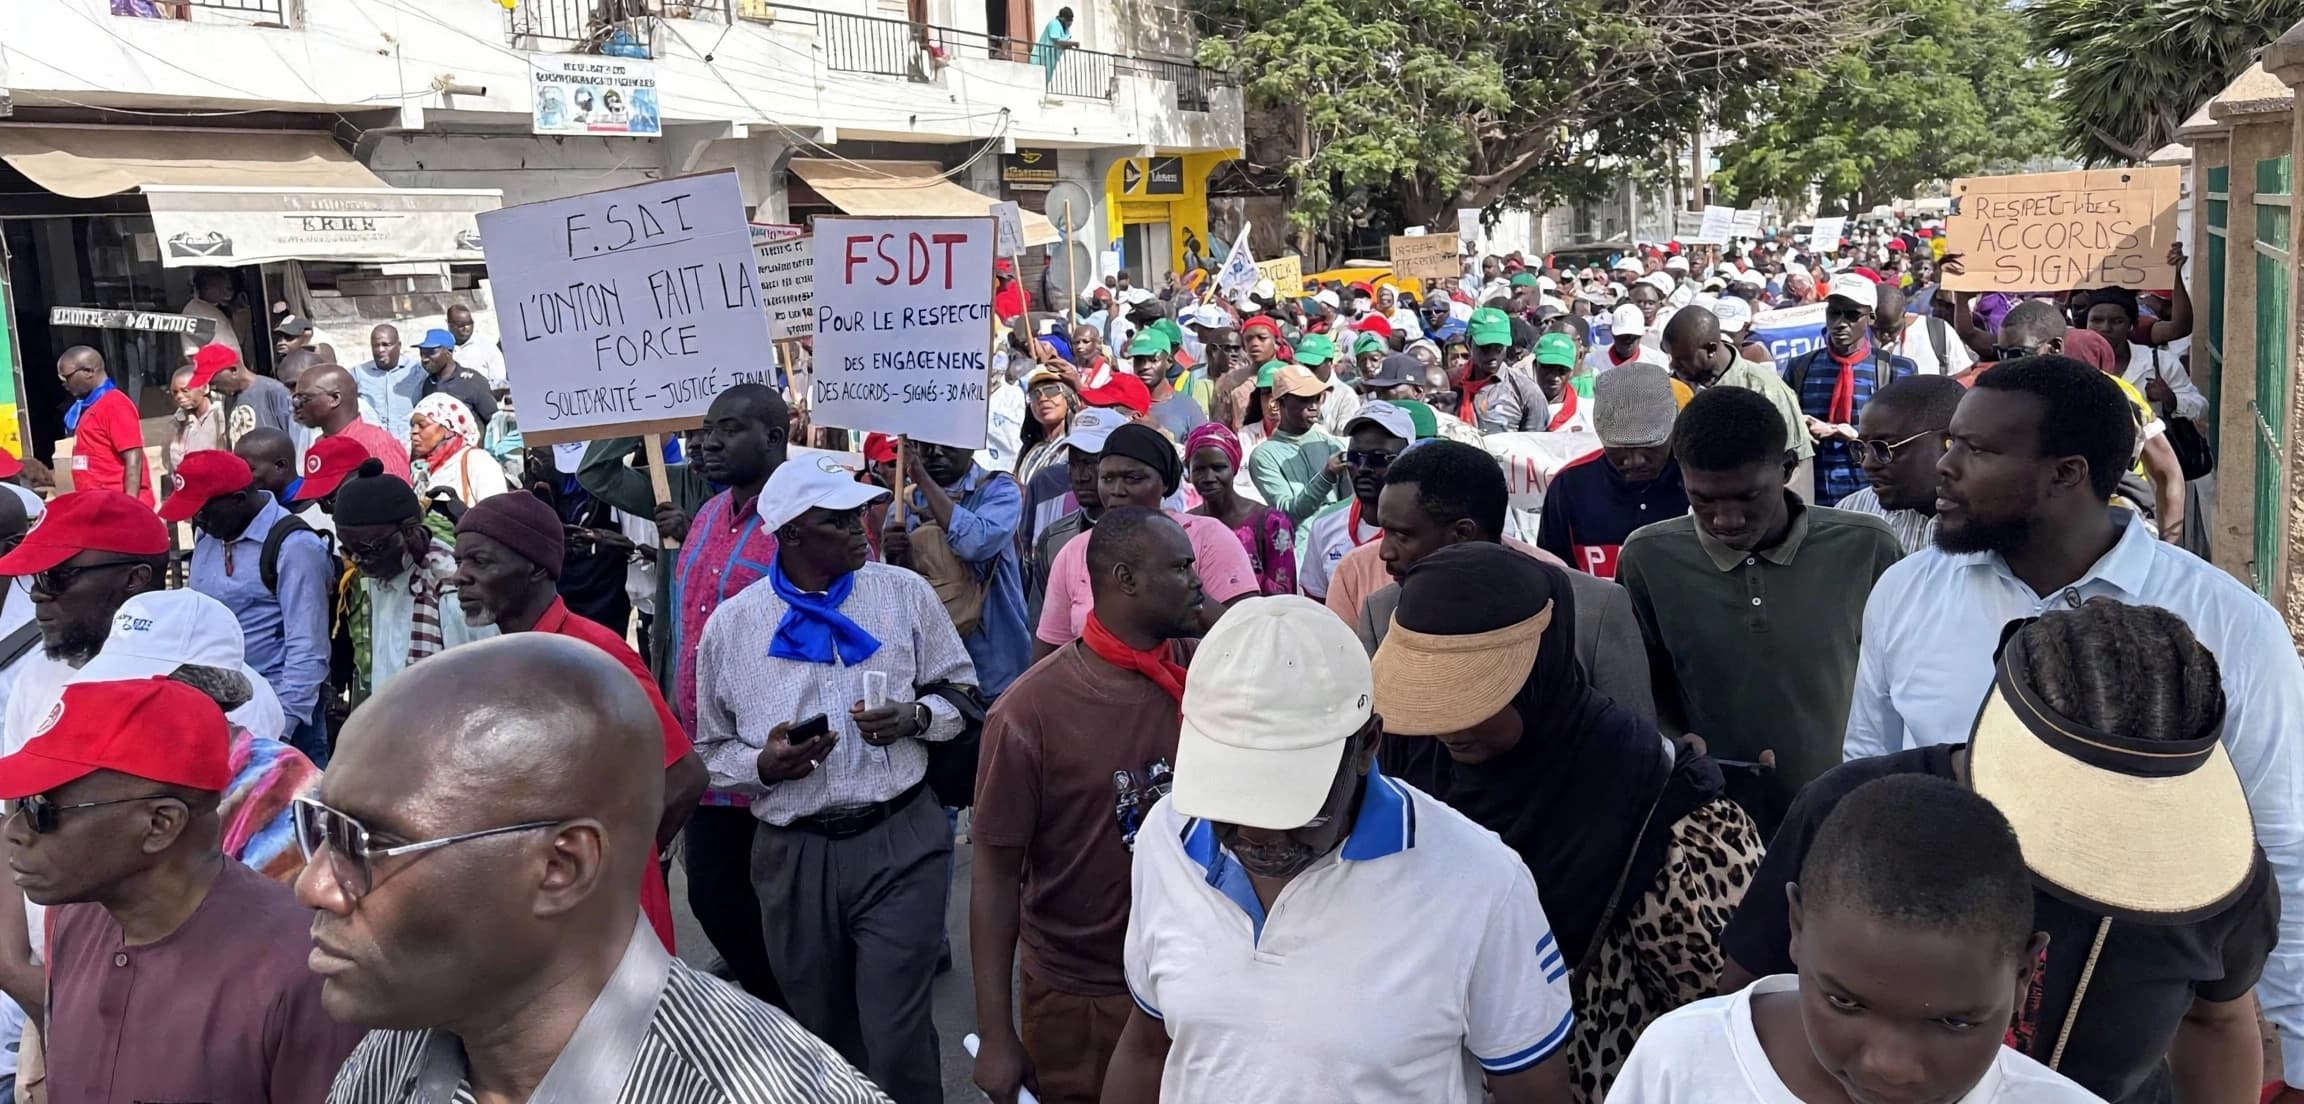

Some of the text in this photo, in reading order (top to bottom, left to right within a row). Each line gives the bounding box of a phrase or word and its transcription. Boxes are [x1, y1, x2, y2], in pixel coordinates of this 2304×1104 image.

[1977, 220, 2139, 252] ACCORDS
[845, 232, 967, 290] FSDT
[1994, 253, 2146, 285] SIGNES
[648, 264, 704, 319] FAIT
[718, 262, 757, 309] LA
[819, 305, 865, 333] POUR
[873, 311, 894, 331] LE
[595, 325, 699, 371] FORCE
[844, 356, 865, 371] DES
[817, 380, 838, 404] DES
[842, 383, 889, 402] ACCORDS
[903, 380, 937, 404] SIGNÉS
[946, 382, 958, 401] 30
[960, 382, 985, 402] AVRIL
